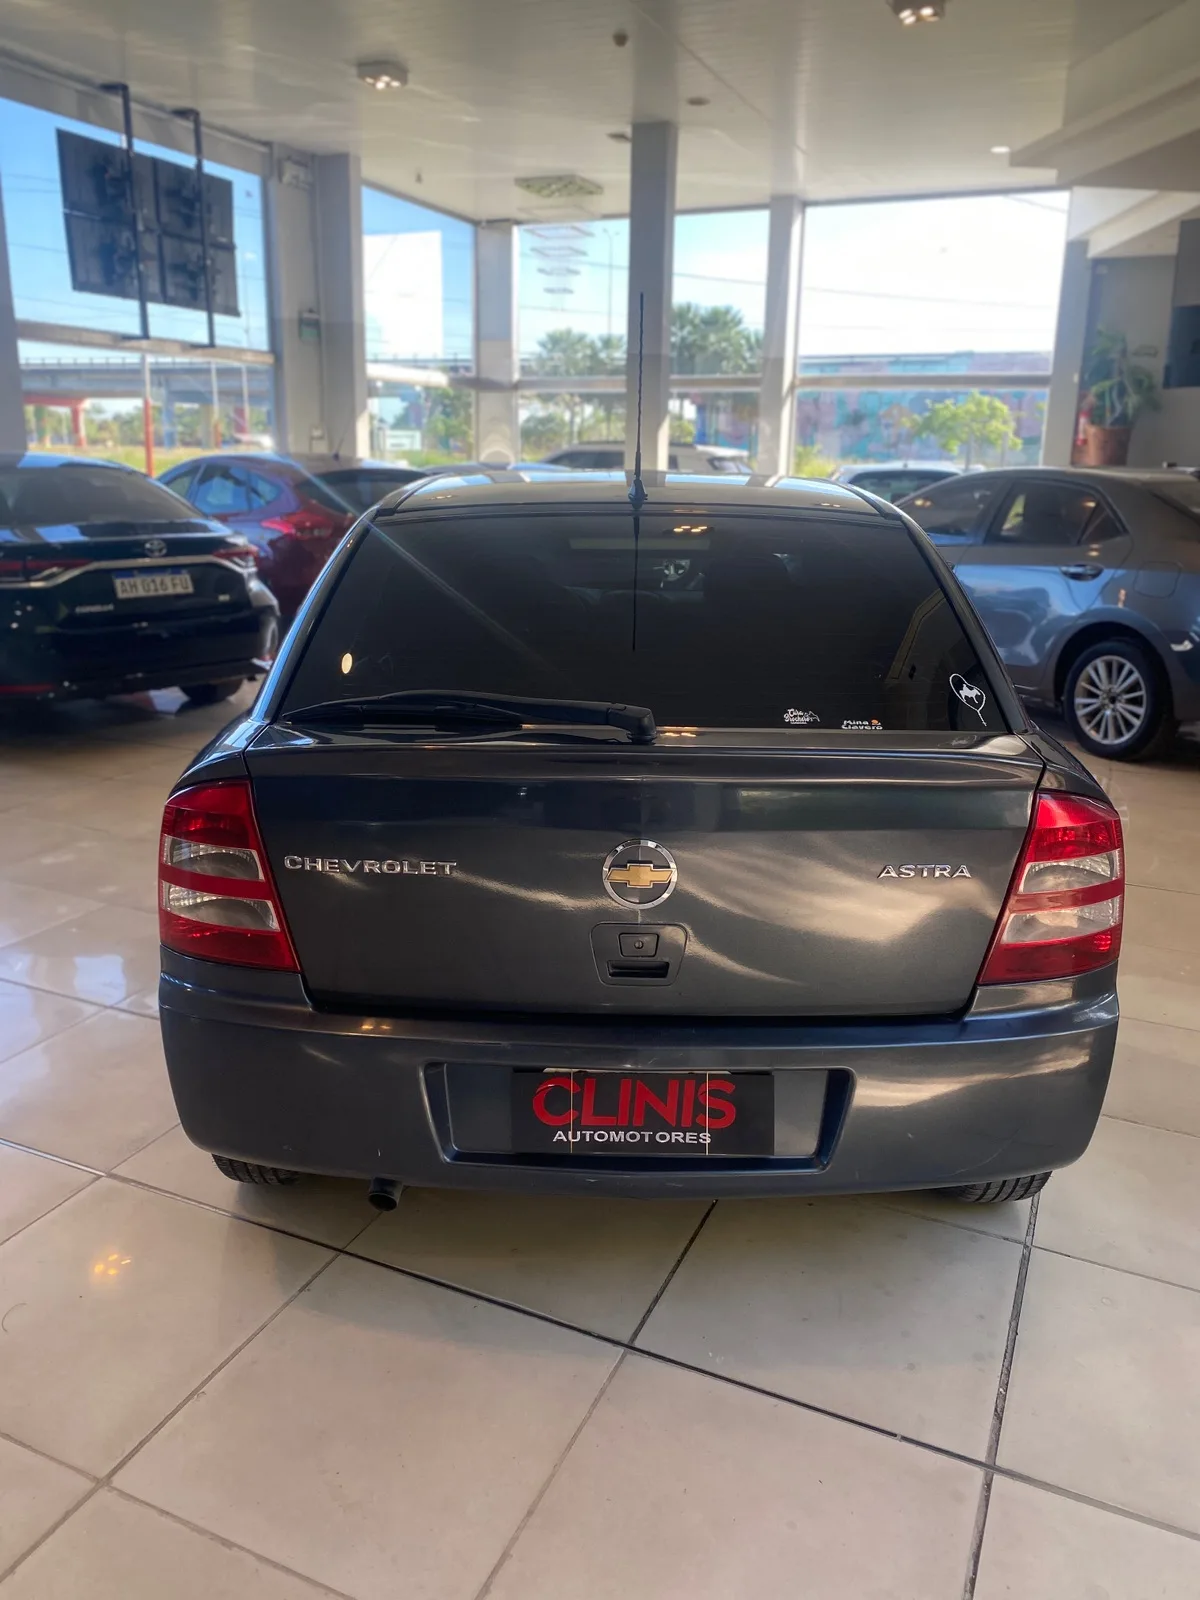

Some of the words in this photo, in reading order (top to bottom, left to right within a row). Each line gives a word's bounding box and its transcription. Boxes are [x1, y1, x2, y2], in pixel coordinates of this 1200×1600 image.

[120, 579, 138, 594] AH
[284, 855, 457, 875] CHEVROLET
[877, 864, 972, 879] ASTRA
[532, 1076, 737, 1129] CLINIS
[552, 1130, 712, 1144] AUTOMOTORES
